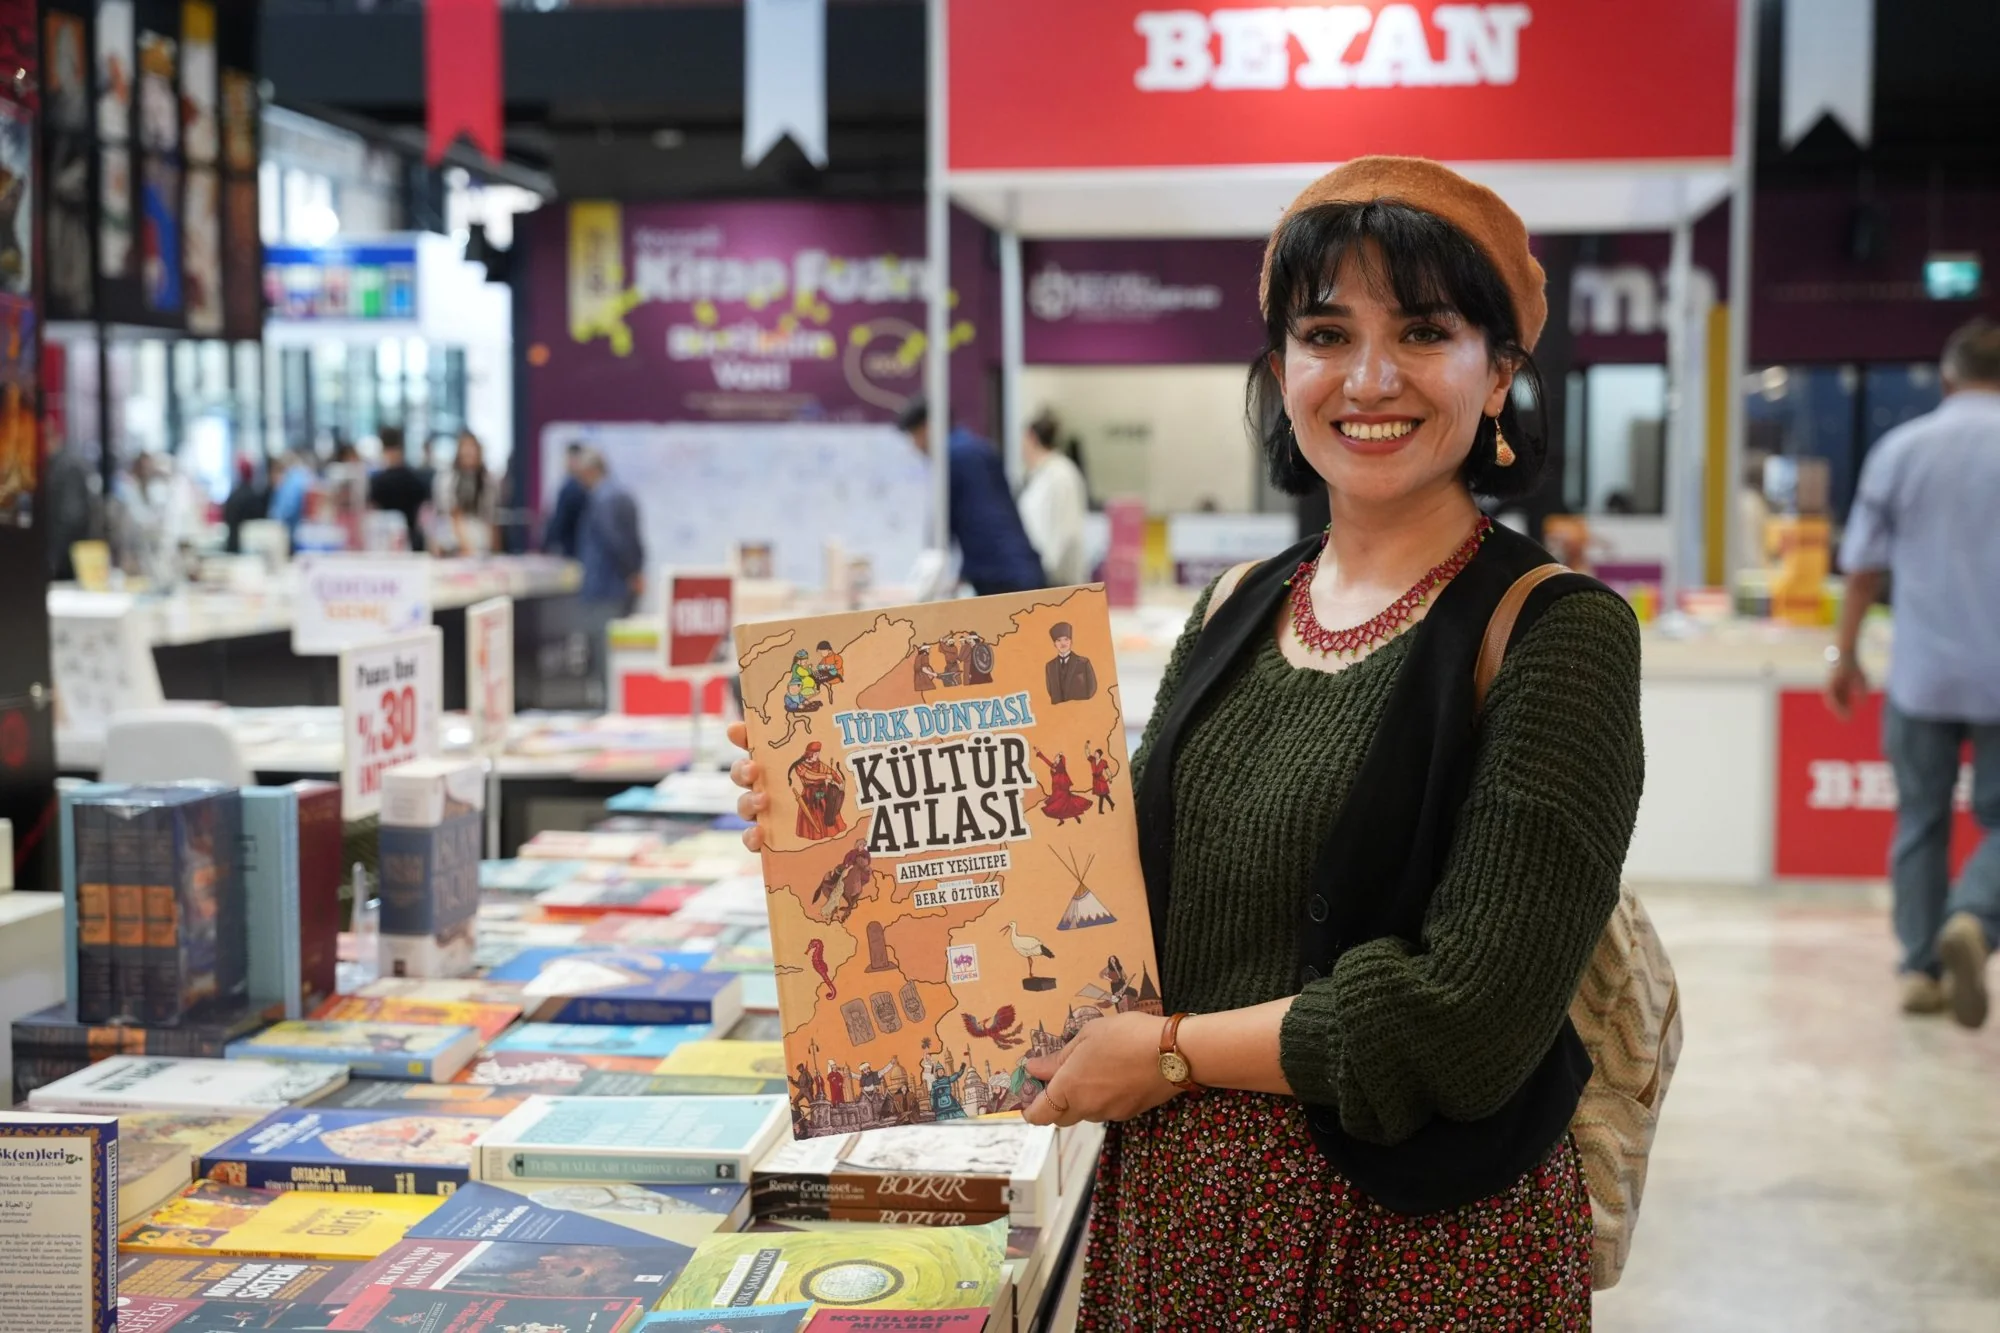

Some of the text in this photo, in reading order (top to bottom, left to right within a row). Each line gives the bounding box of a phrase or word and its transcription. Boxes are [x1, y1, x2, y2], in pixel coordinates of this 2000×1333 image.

[1134, 5, 1533, 91] BEYAN
[634, 256, 787, 304] Kitap
[836, 693, 1033, 746] TÜRK DÜNYASI
[852, 736, 1032, 805] KÜLTÜR
[867, 789, 1027, 852] ATLASI
[900, 853, 1008, 880] AHMET YEŞİLTEPE
[915, 884, 999, 907] BERK ÖZTÜRK
[291, 1165, 346, 1184] ORTAÇAĞ'DA
[769, 1179, 798, 1192] René
[799, 1180, 851, 1194] Grousset
[877, 1174, 976, 1202] BOZKIR
[306, 1206, 384, 1237] Giriş
[235, 1263, 309, 1299] SİSTEMİ
[402, 1251, 454, 1289] AMANİZMİ
[829, 1314, 970, 1322] KÖTÜLÜĞÜN
